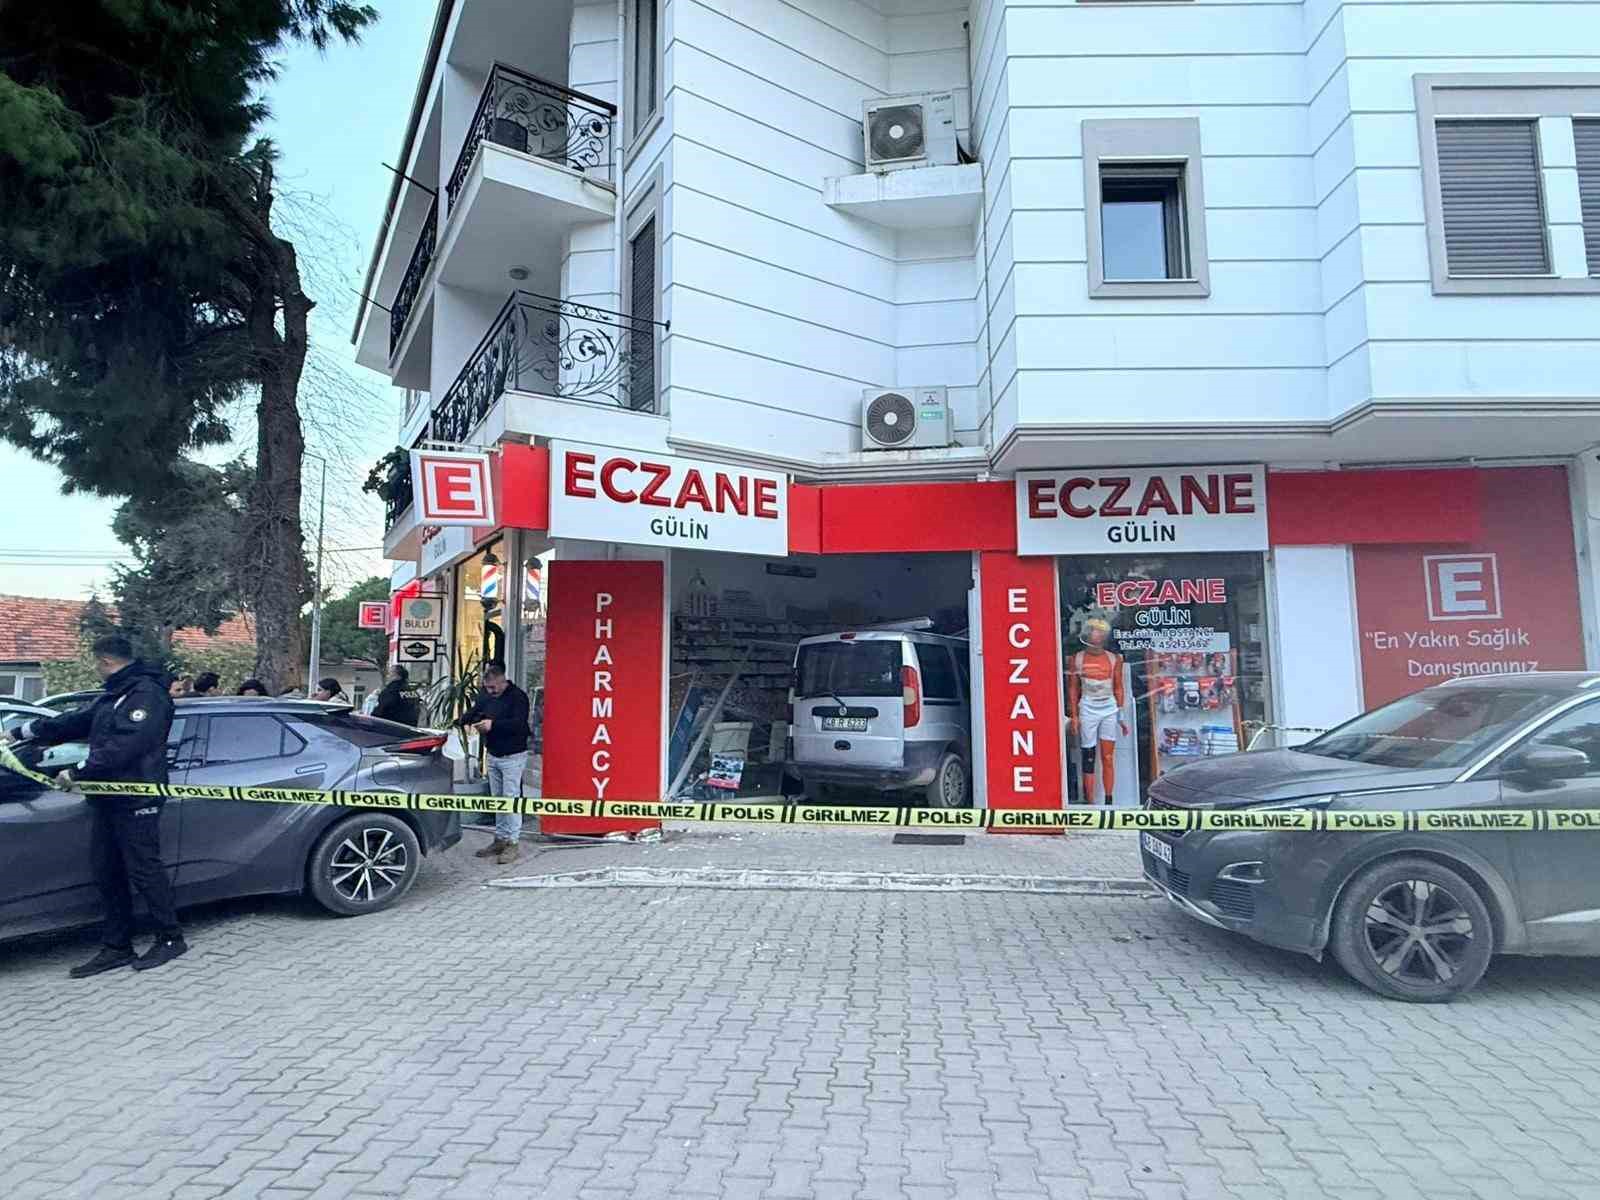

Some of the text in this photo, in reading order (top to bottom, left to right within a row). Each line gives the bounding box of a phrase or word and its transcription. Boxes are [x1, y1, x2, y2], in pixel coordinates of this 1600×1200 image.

[433, 466, 476, 511] E
[564, 451, 779, 519] ECZANE
[1028, 473, 1256, 519] ECZANE
[650, 516, 709, 540] GÜLİN
[1107, 521, 1176, 543] GÜLİN
[1097, 579, 1227, 607] ECZANE
[1438, 562, 1488, 612] E
[404, 620, 435, 629] BULUT
[1135, 606, 1192, 626] GÜLİN
[1403, 630, 1460, 649] Yakın
[1467, 628, 1530, 650] Sağlık
[591, 592, 613, 799] PHARMACY
[1008, 588, 1035, 793] ECZANE
[174, 787, 224, 798] POLİS
[247, 790, 326, 802] GİRİLMEZ
[350, 794, 400, 806] POLİS
[426, 797, 508, 811] GİRİLMEZ
[532, 801, 584, 813] POLİS
[610, 803, 695, 818] GİRİLMEZ
[721, 807, 774, 820] POLİS
[802, 810, 889, 823] GİRİLMEZ
[917, 811, 973, 824] POLİS
[1002, 812, 1093, 826] GİRİLMEZ
[1121, 813, 1180, 826] POLİS
[1210, 814, 1305, 827] GİRİLMEZ
[1335, 814, 1396, 827] POLİS
[1427, 814, 1524, 827] GİRİLMEZ
[1556, 813, 1600, 826] POL
